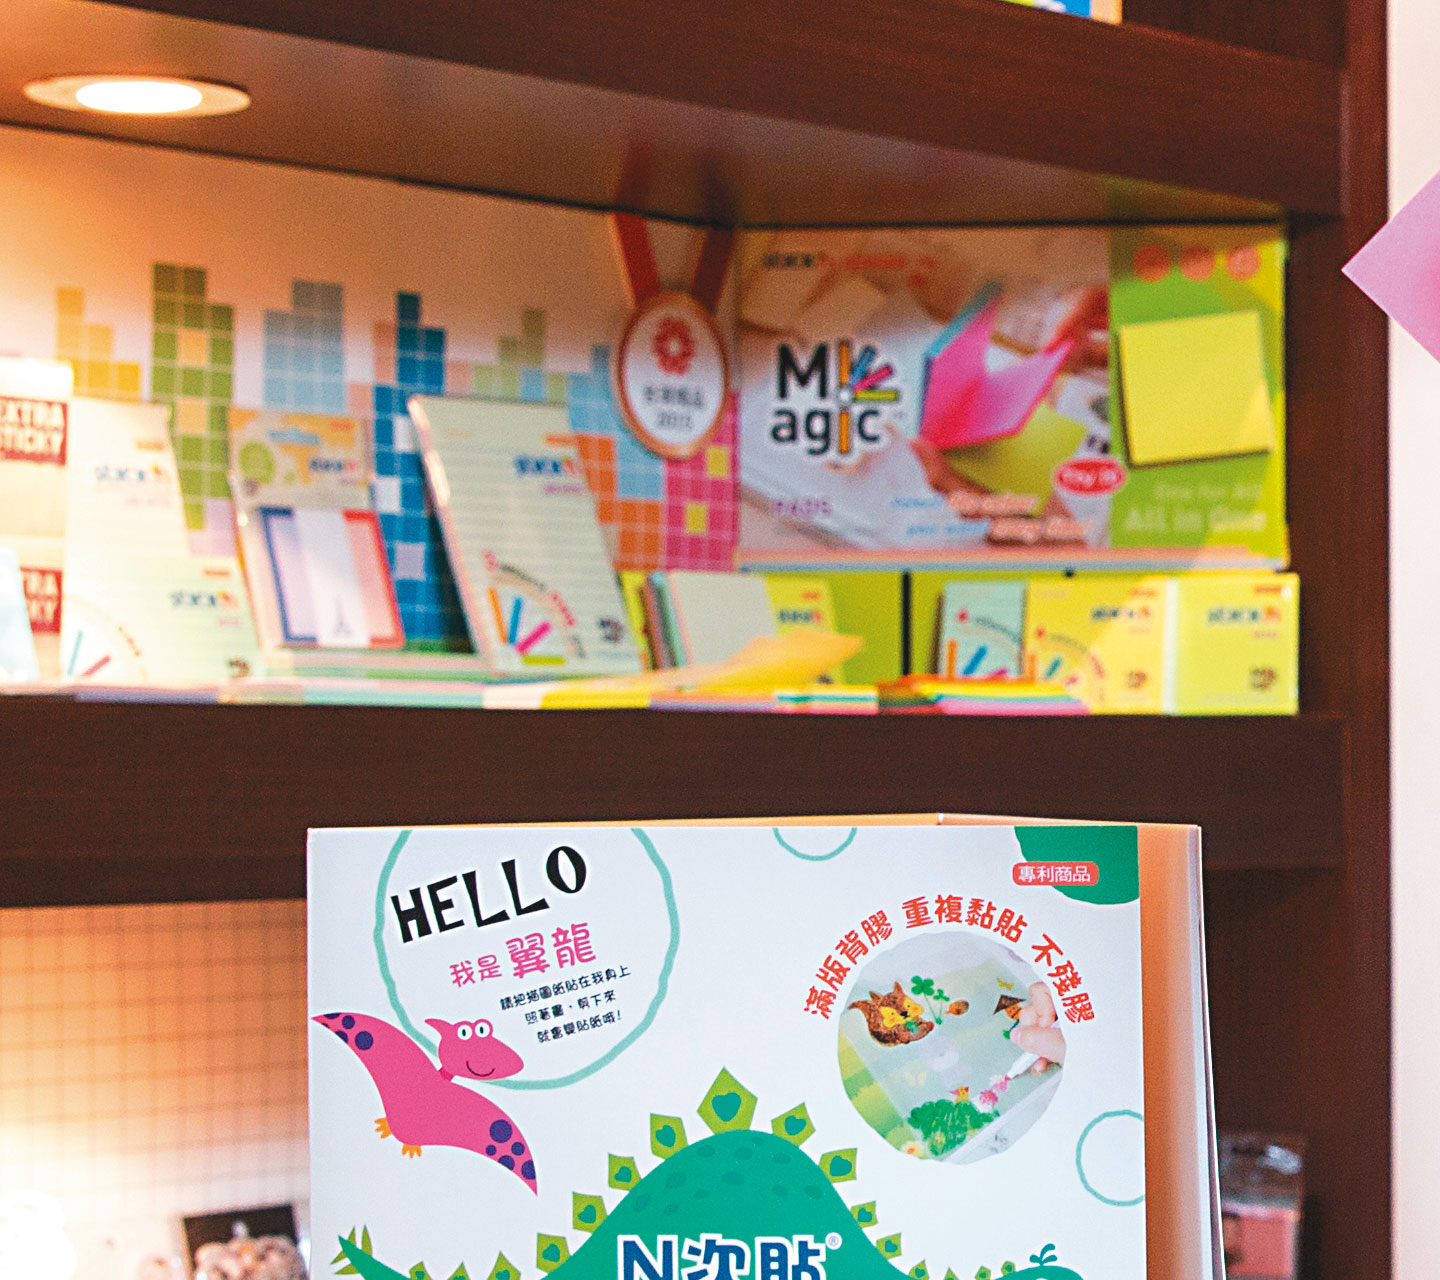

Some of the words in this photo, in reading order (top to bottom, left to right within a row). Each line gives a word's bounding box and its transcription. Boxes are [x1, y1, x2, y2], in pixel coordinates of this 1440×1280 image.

[390, 845, 588, 944] HELLO
[1017, 864, 1092, 884] 專利商品
[901, 893, 1029, 944] 重複黏貼
[1031, 932, 1096, 1025] 不殘膠
